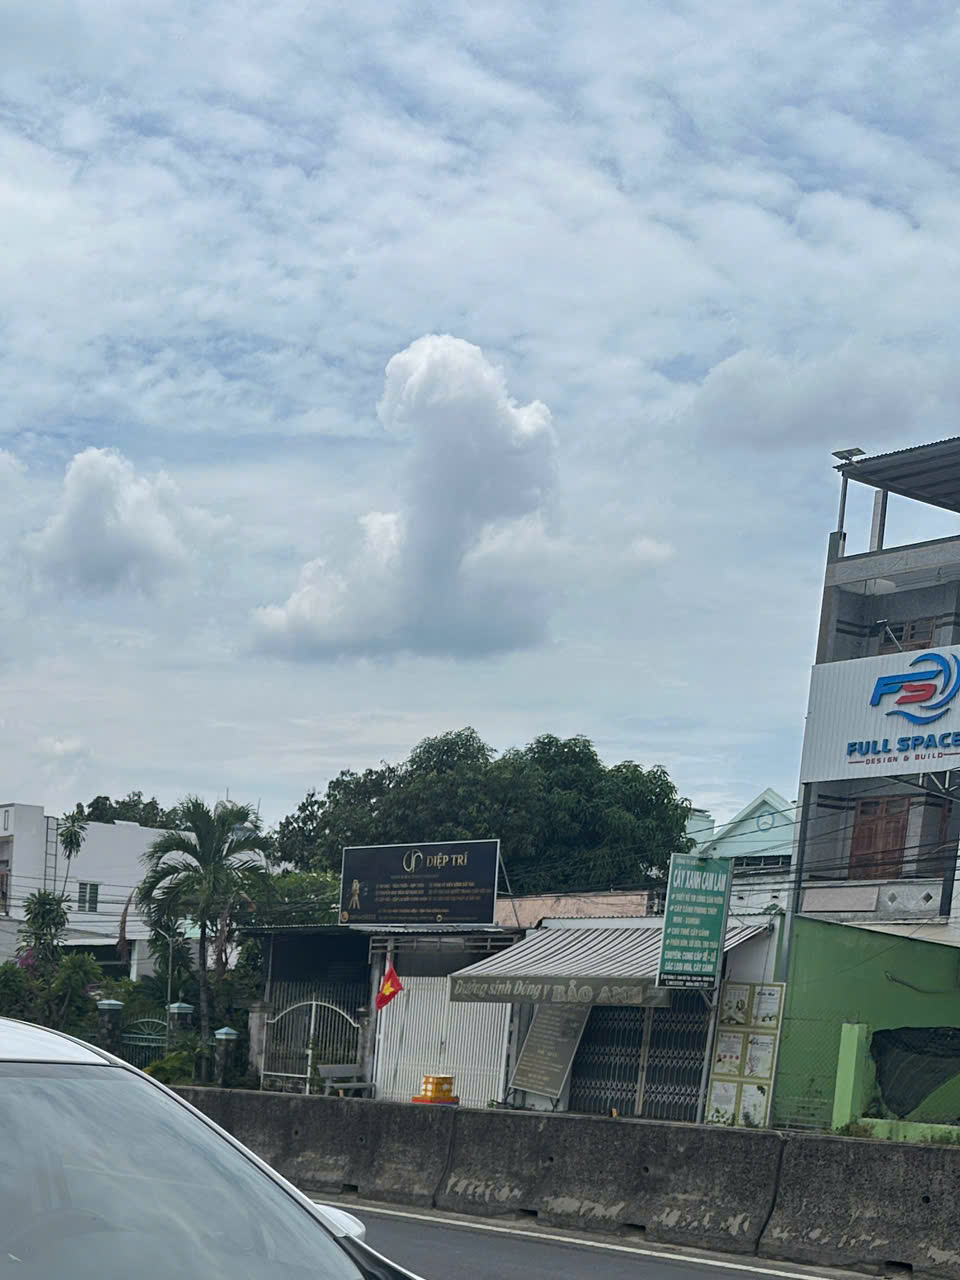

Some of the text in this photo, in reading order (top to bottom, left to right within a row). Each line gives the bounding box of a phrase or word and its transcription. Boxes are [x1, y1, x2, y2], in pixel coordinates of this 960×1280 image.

[846, 731, 960, 757] FULL SPACE
[865, 752, 944, 765] DESIGN & BUILD
[426, 851, 468, 870] DIỆP TRÍ
[673, 867, 686, 888] CÂY
[685, 869, 702, 889] XANH
[489, 980, 512, 995] sinh
[551, 979, 593, 1003] BẢO
